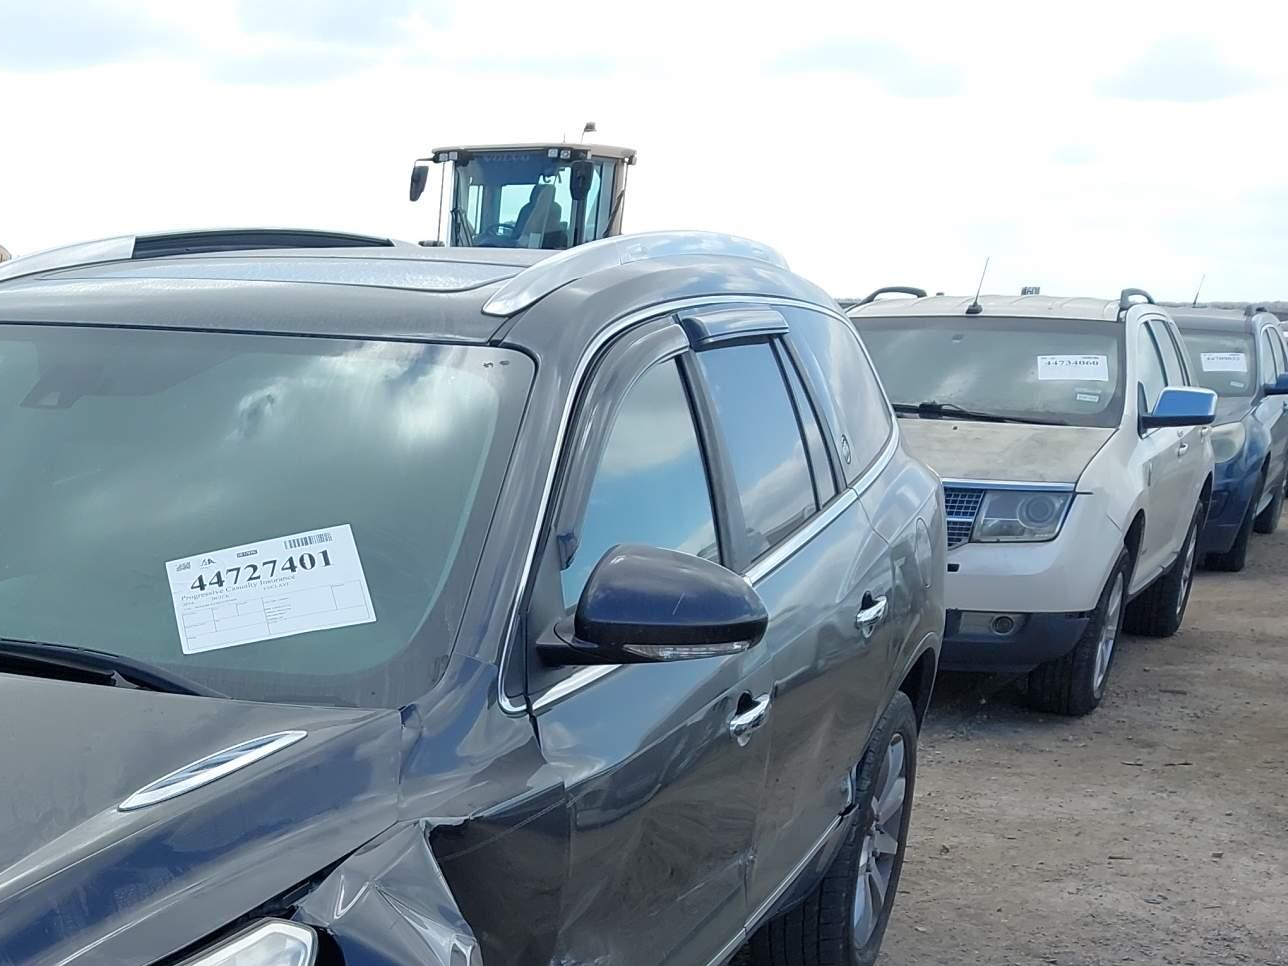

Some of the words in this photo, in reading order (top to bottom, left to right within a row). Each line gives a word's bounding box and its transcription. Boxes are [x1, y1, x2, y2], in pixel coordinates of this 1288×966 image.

[190, 549, 334, 591] 44727401
[181, 587, 224, 601] Progressive
[226, 579, 258, 593] Casualty
